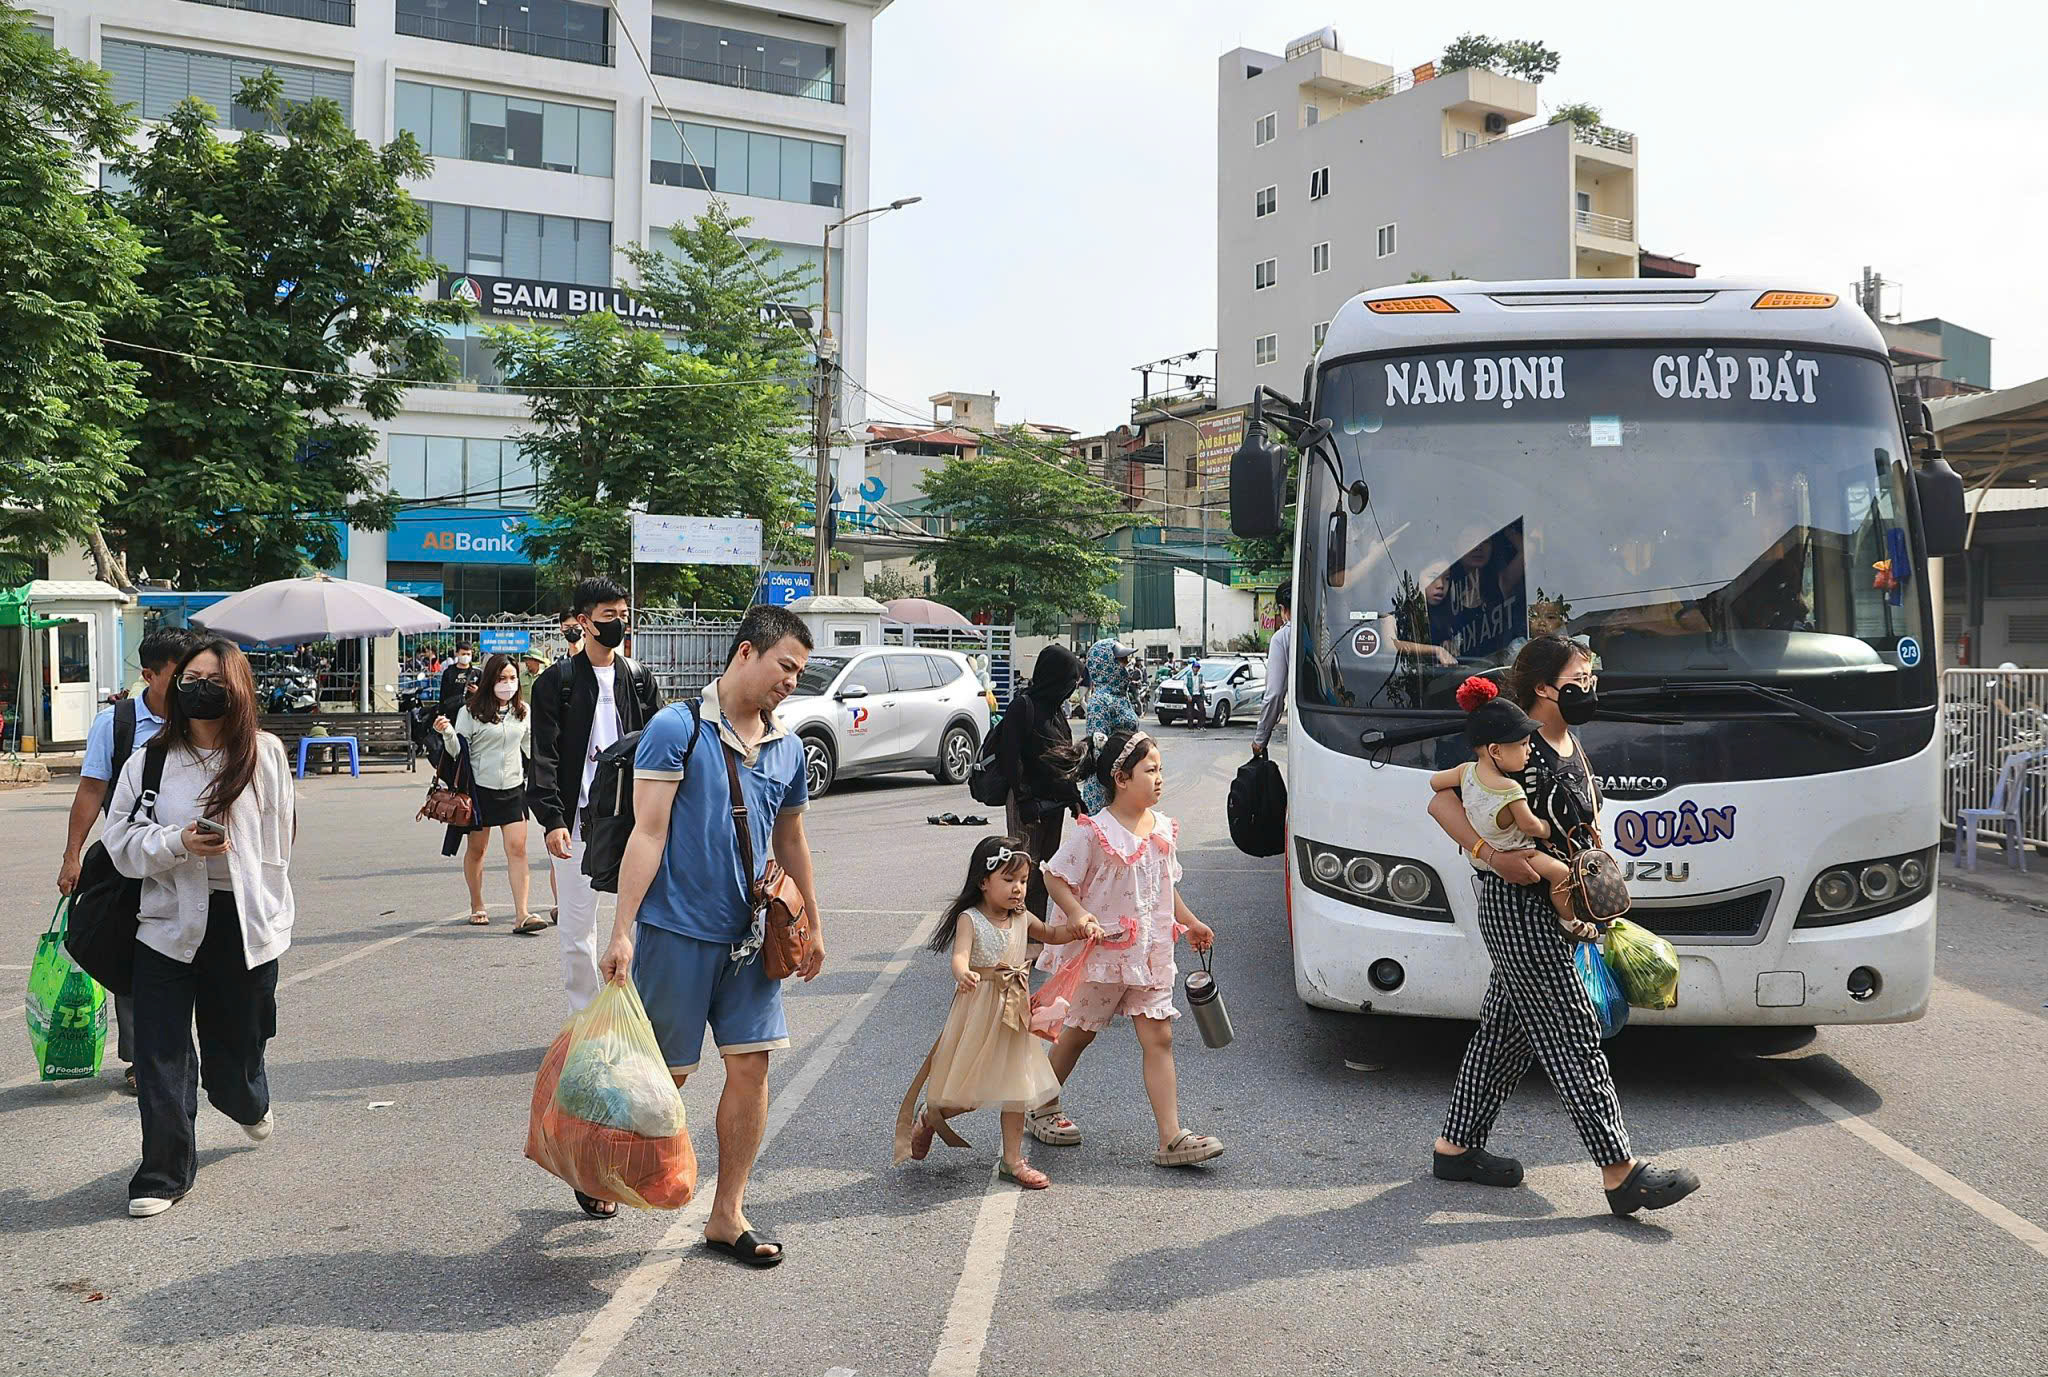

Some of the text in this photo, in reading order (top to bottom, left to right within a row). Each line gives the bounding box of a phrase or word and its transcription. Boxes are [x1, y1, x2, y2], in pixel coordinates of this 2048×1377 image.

[492, 282, 664, 320] SAM BILLIA
[1384, 348, 1820, 409] NAM ĐỊNH GIÁP BÁT
[423, 531, 515, 552] ABBank
[771, 574, 793, 586] CỔNG
[793, 576, 809, 586] VÀO
[784, 588, 795, 602] 2
[1901, 646, 1917, 658] 2/3
[1594, 776, 1668, 791] SAMCO
[1614, 799, 1737, 857] QUÂN
